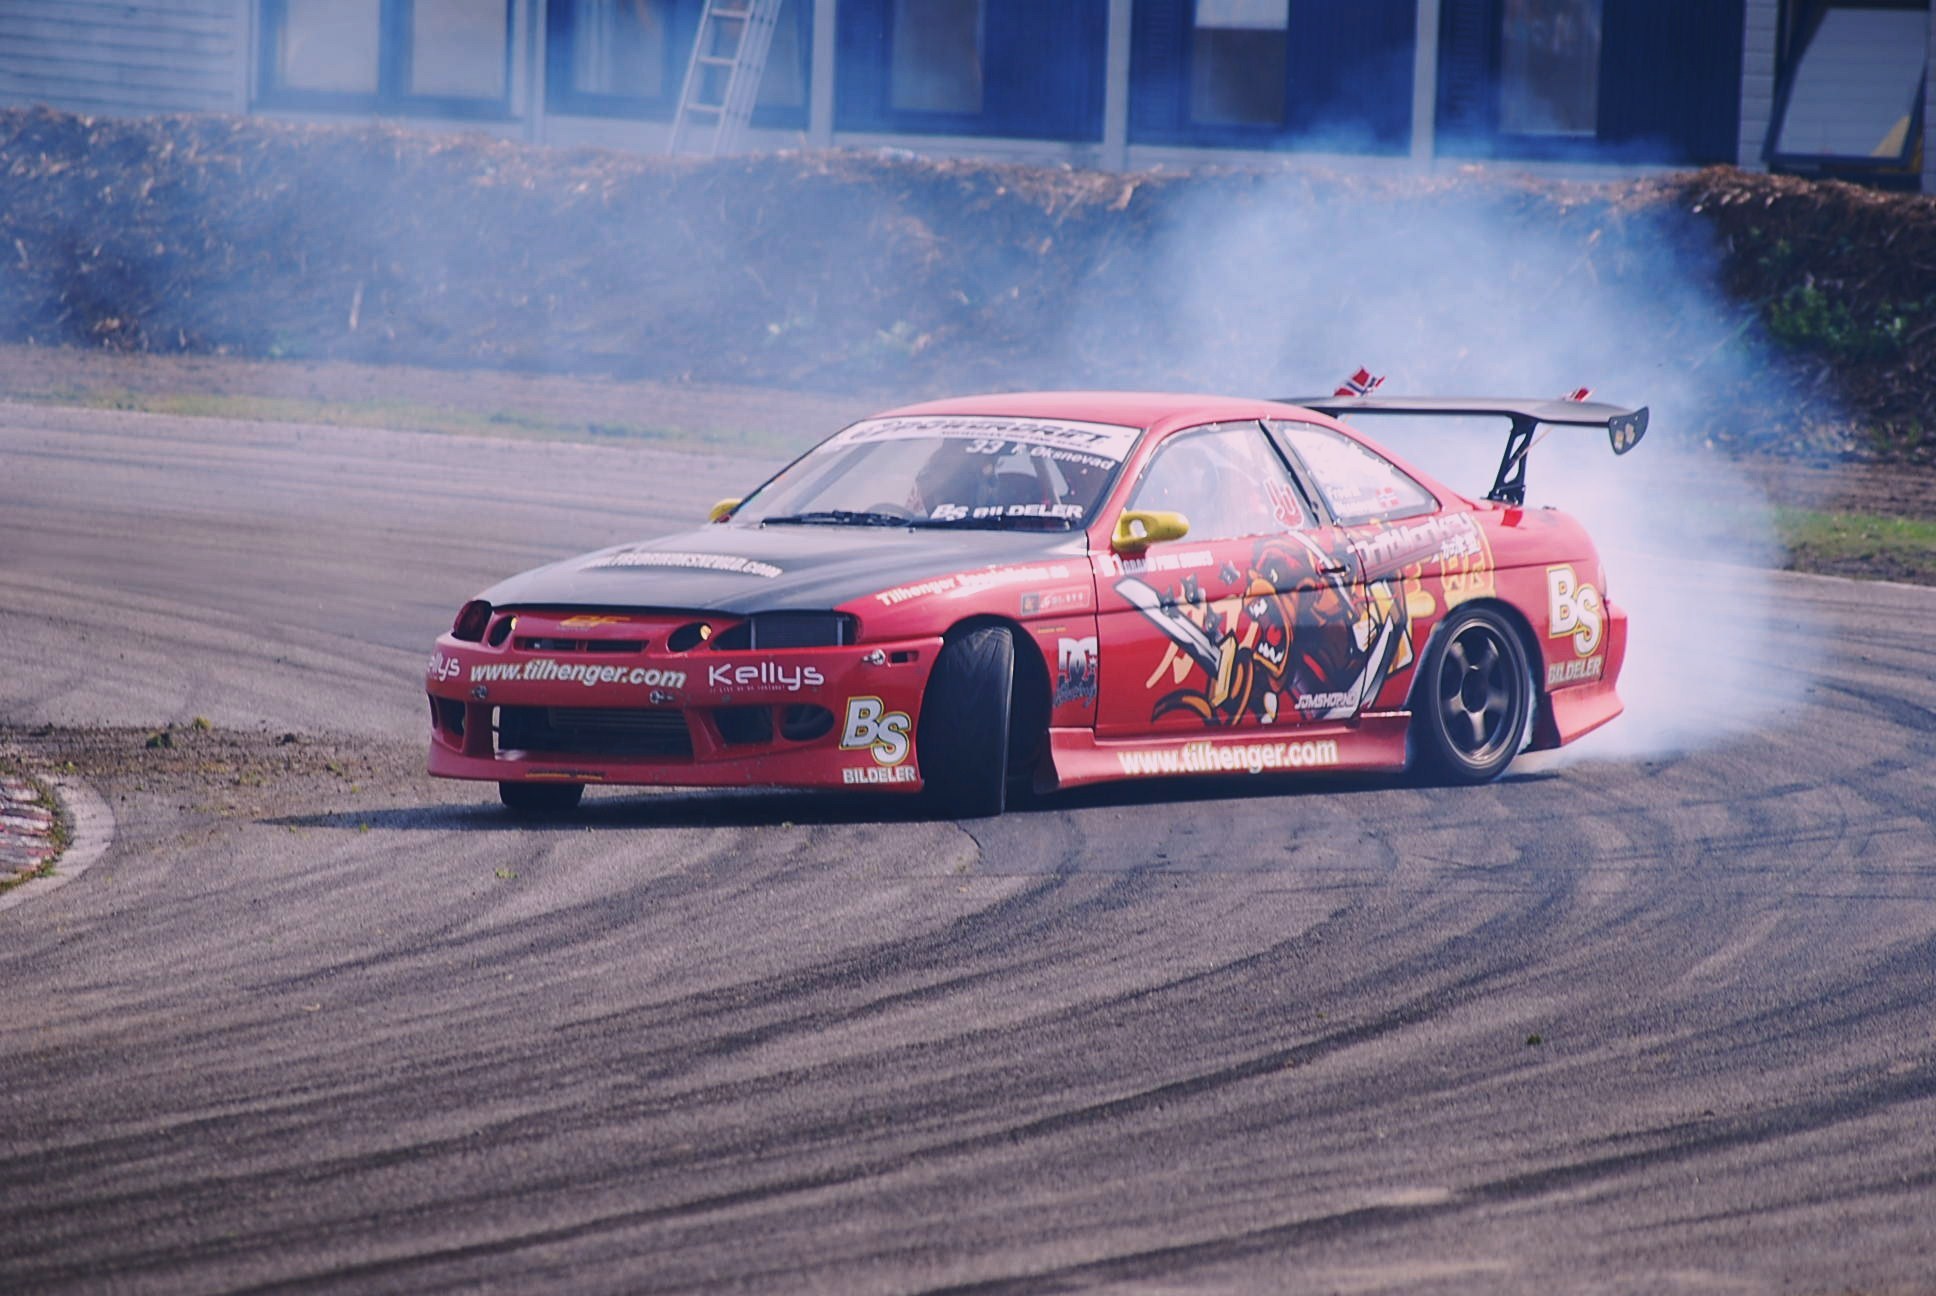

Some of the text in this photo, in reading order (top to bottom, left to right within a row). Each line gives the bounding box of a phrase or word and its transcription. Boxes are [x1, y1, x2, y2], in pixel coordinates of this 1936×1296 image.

[1546, 563, 1602, 658] BS
[470, 659, 687, 689] www.tilhenger.com
[708, 661, 825, 691] Kellys
[1547, 655, 1603, 685] BILDELER
[839, 695, 912, 768] BS
[1118, 739, 1340, 774] www.tilhenger.com
[842, 764, 917, 784] BILDELER
